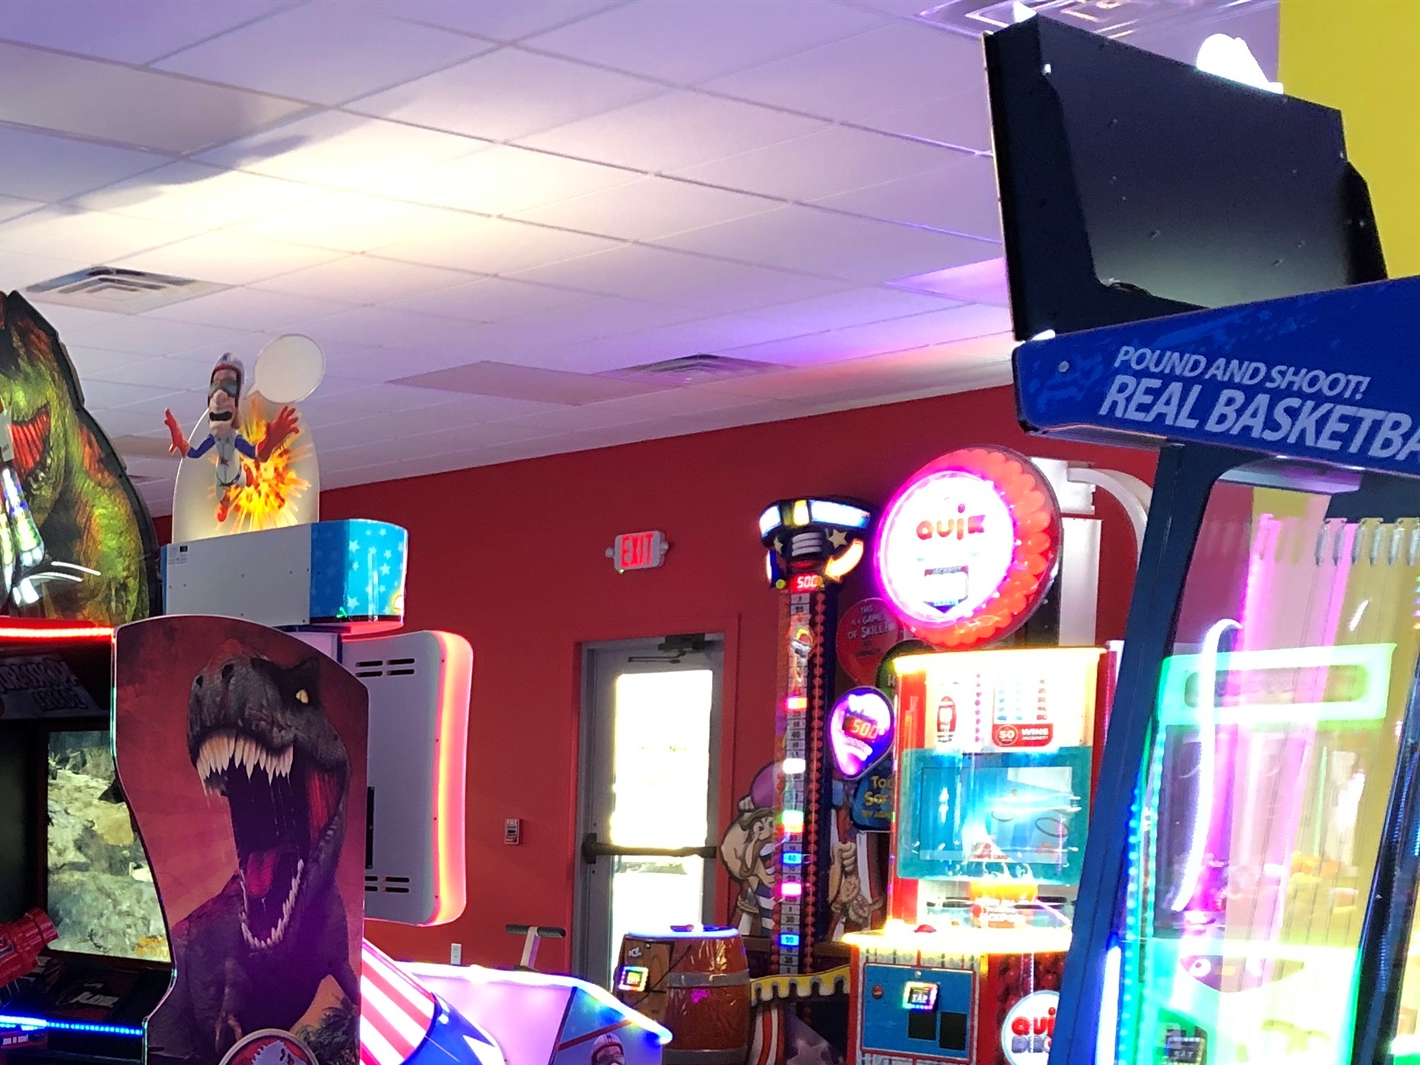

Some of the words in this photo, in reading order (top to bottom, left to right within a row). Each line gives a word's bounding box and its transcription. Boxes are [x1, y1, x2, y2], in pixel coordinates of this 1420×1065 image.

[1113, 345, 1206, 379] POUND
[1207, 357, 1267, 386] AND
[1267, 365, 1372, 400] SHOOT!
[1098, 374, 1203, 430] REAL
[621, 532, 656, 567] EXIT
[851, 719, 878, 740] 500
[912, 993, 928, 1003] TAP
[1011, 1007, 1056, 1036] QUI
[1011, 1035, 1052, 1053] DRO
